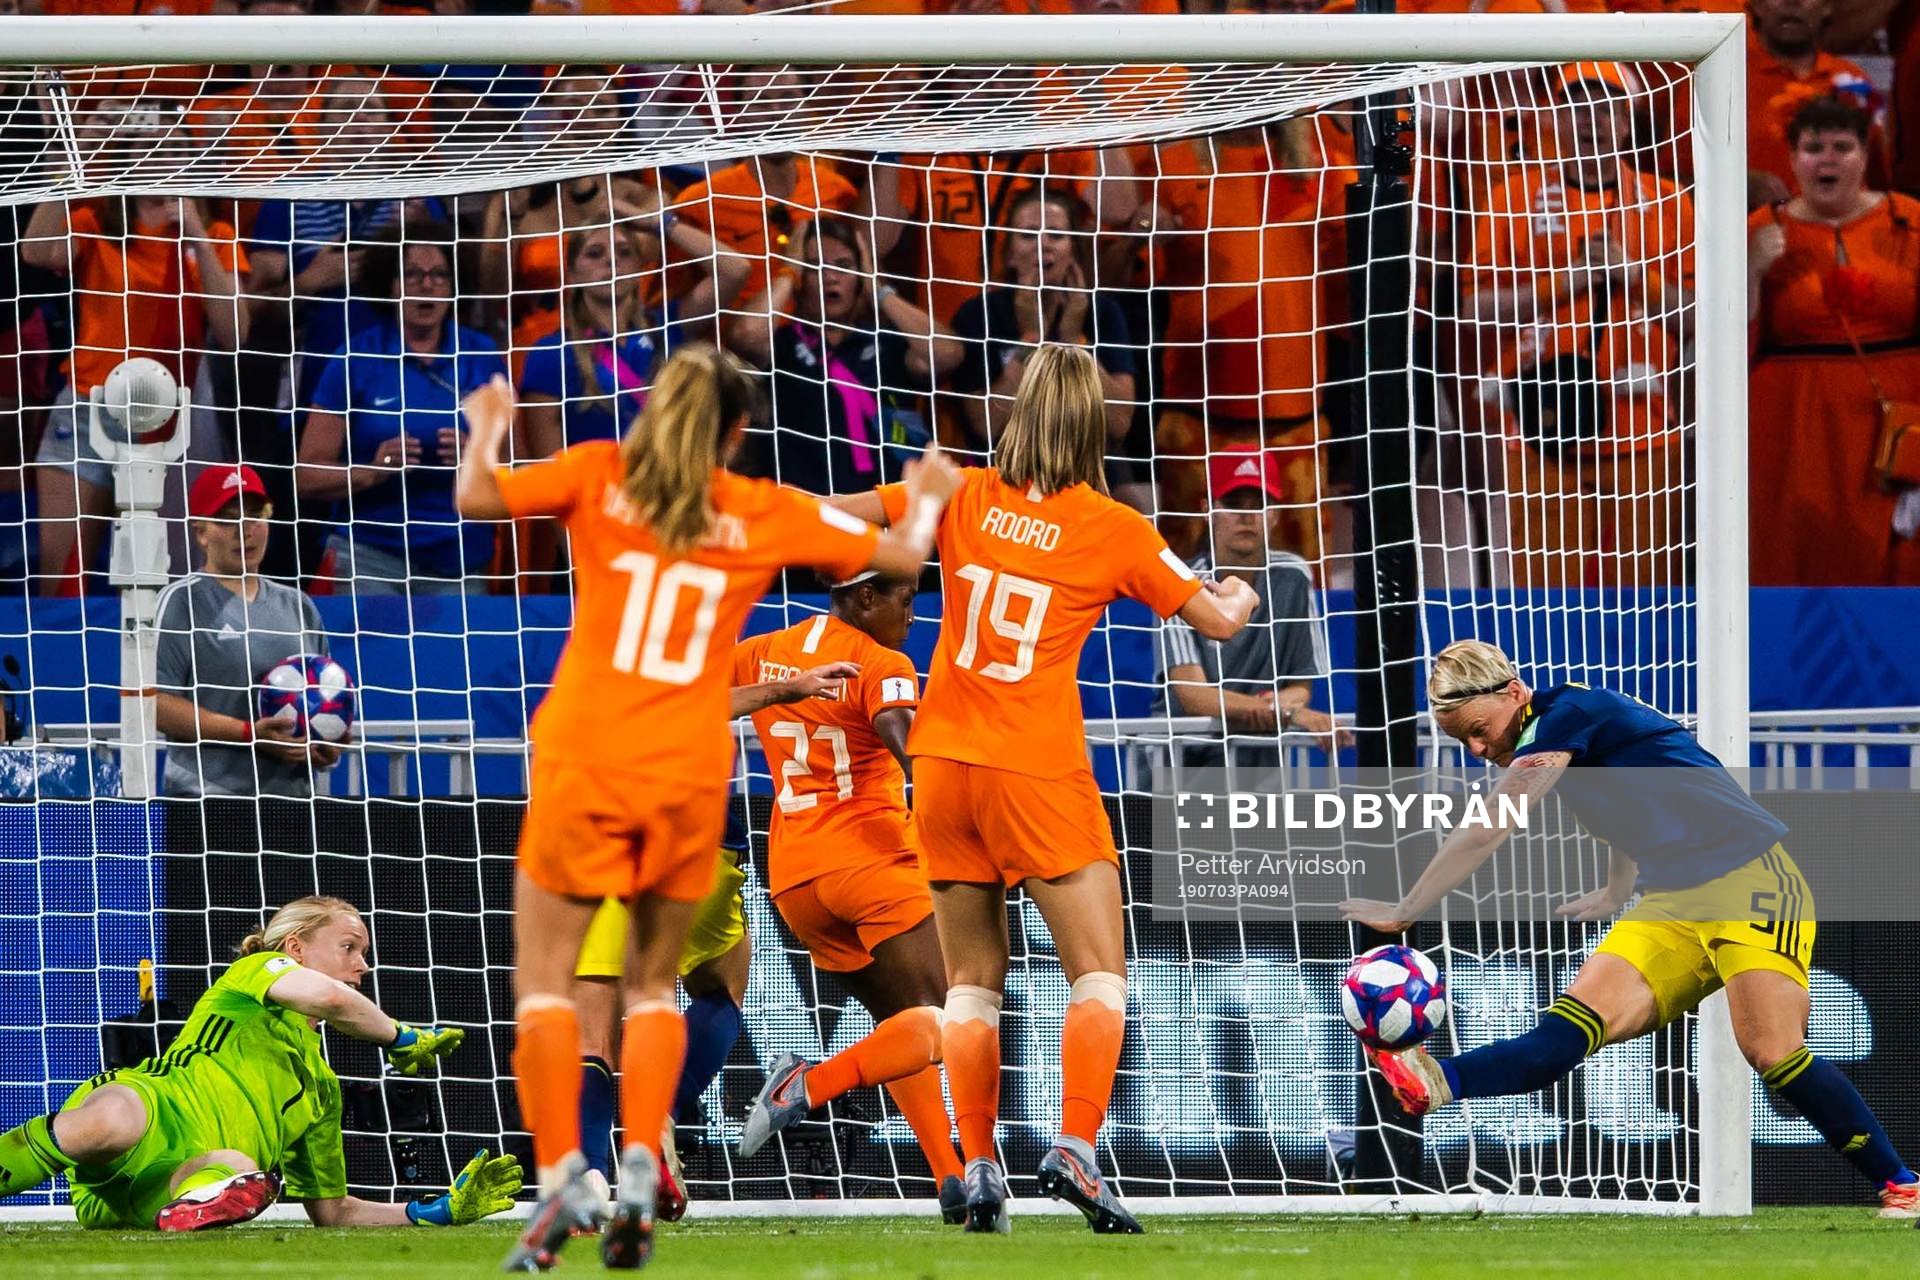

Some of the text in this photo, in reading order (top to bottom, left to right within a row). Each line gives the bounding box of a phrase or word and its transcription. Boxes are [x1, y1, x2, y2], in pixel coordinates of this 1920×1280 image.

[980, 506, 1062, 551] ROORD
[608, 550, 728, 686] 10
[954, 563, 1054, 684] 19
[769, 720, 854, 814] 21
[1749, 891, 1777, 935] 5
